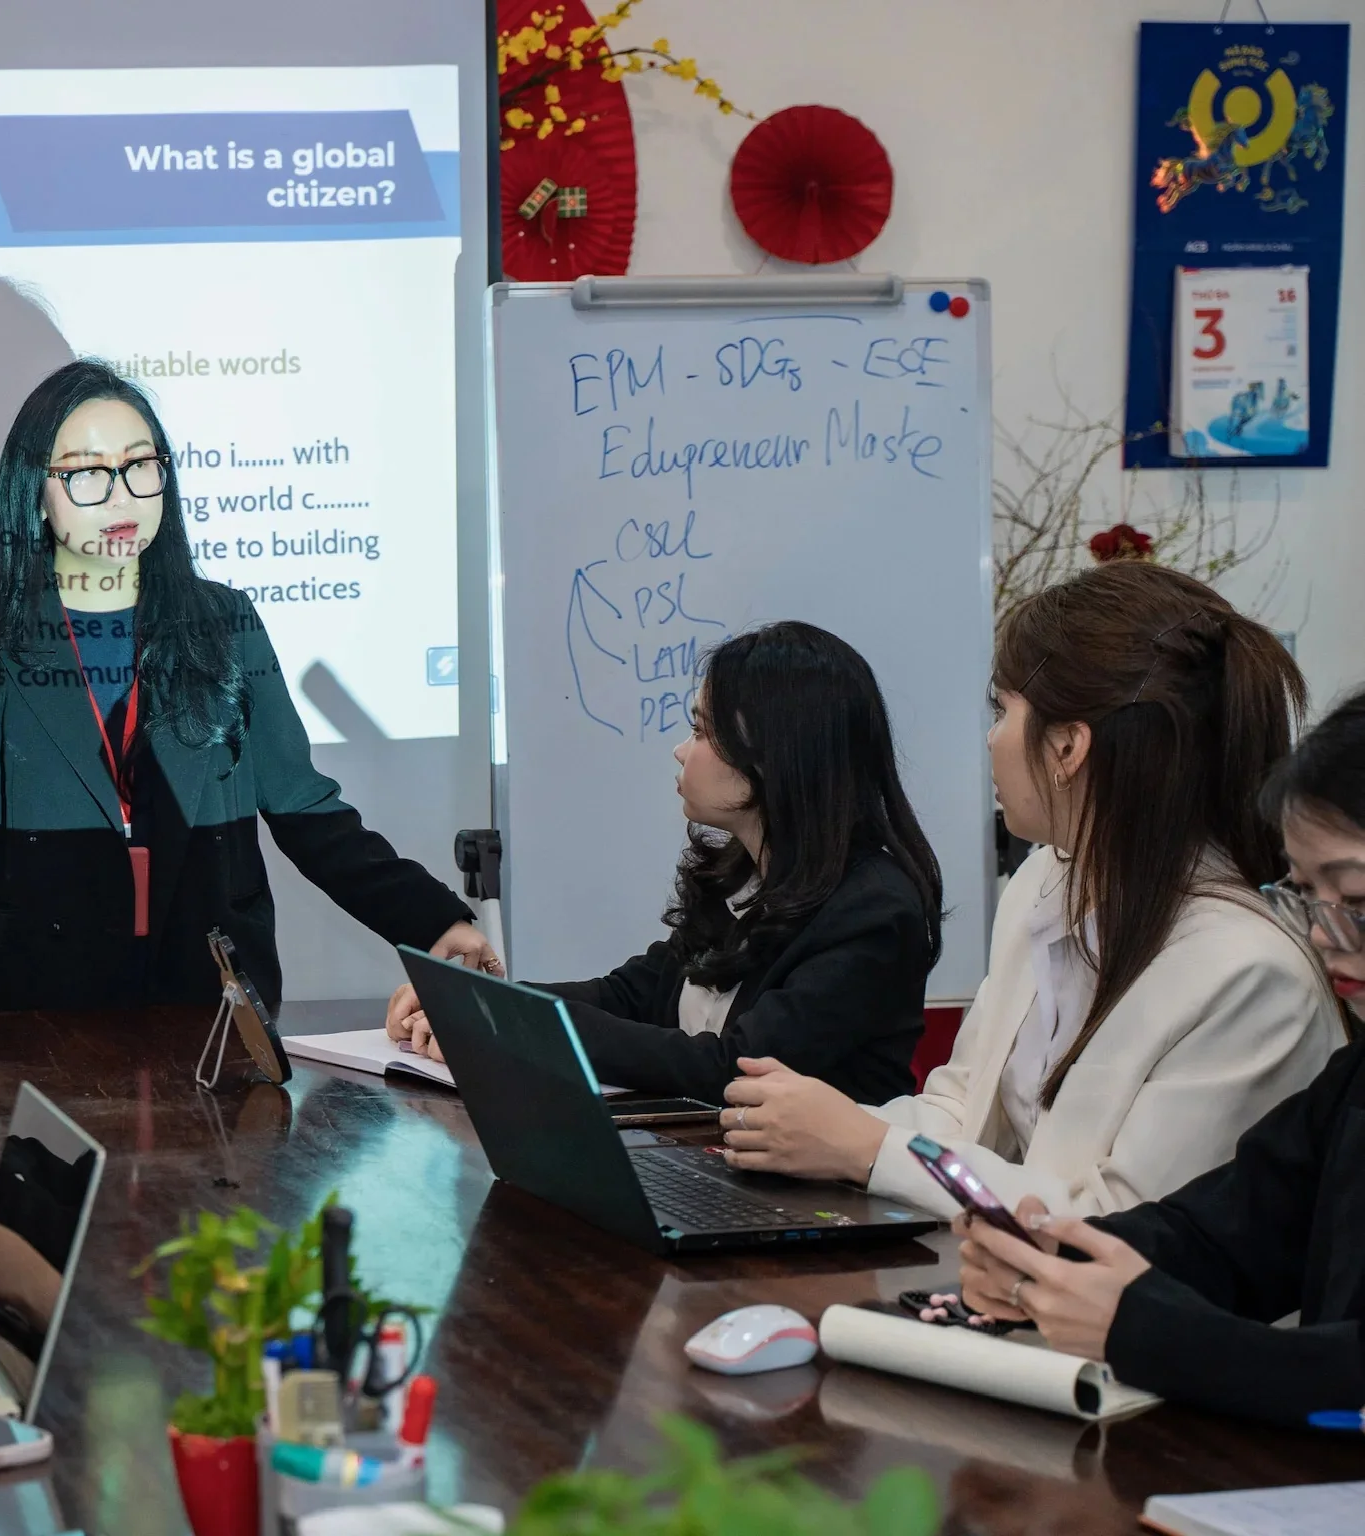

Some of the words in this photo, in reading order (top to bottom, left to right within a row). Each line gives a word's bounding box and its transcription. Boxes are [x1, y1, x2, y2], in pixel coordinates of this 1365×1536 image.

[125, 143, 218, 173] What
[227, 140, 255, 171] is
[264, 148, 283, 171] a
[292, 141, 396, 177] global
[266, 179, 396, 208] citizen?
[1191, 309, 1227, 360] 3
[109, 350, 211, 378] uitable
[219, 348, 302, 376] words
[569, 345, 665, 416] EPM
[293, 437, 350, 465] with
[218, 485, 293, 513] world
[237, 537, 264, 559] to
[273, 528, 381, 560] building
[99, 566, 127, 592] of
[244, 576, 361, 603] practices
